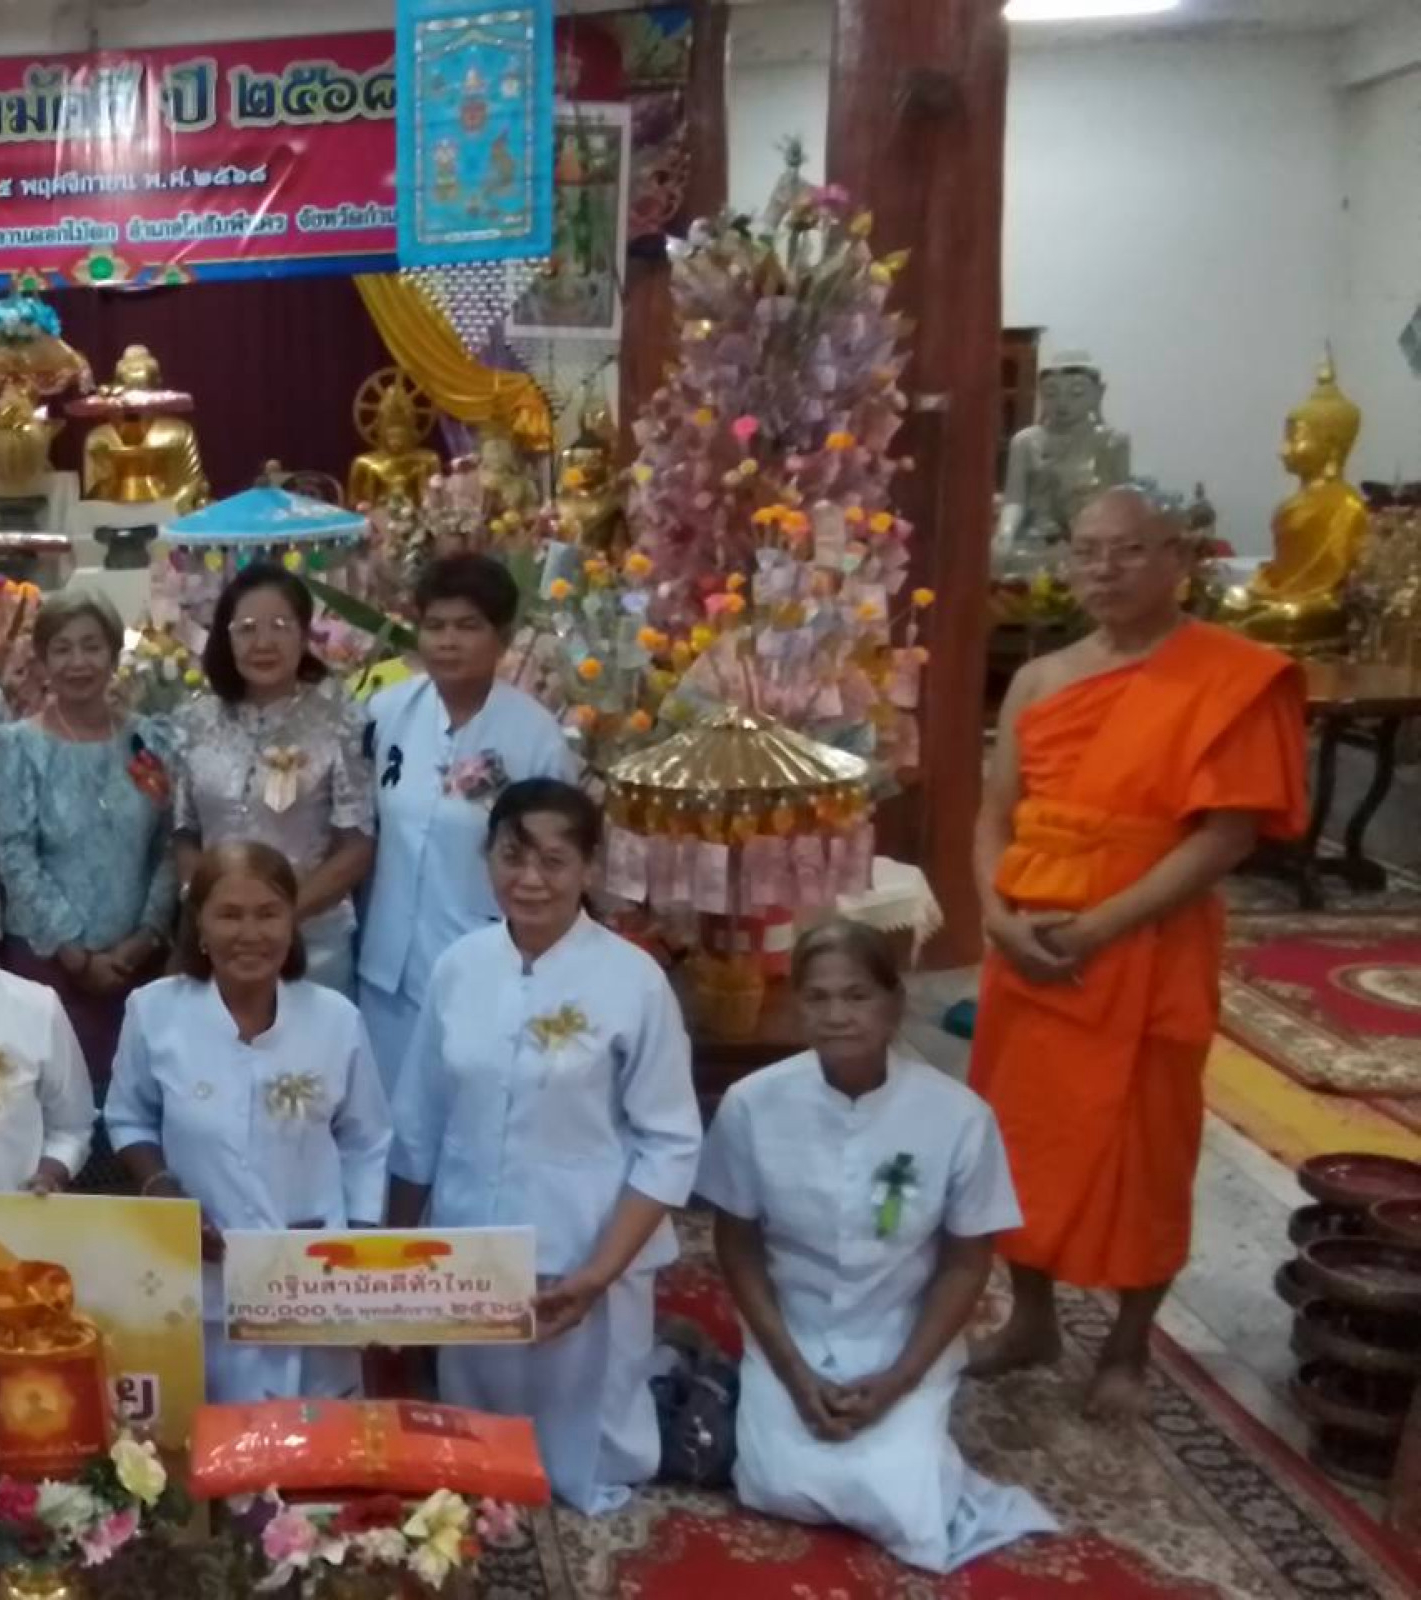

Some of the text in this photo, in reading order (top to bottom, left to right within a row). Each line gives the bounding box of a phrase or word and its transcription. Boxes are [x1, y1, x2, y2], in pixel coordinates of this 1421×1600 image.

[162, 61, 213, 125] ปี
[268, 1270, 491, 1299] กฐินสามัคคีทั่วไทย
